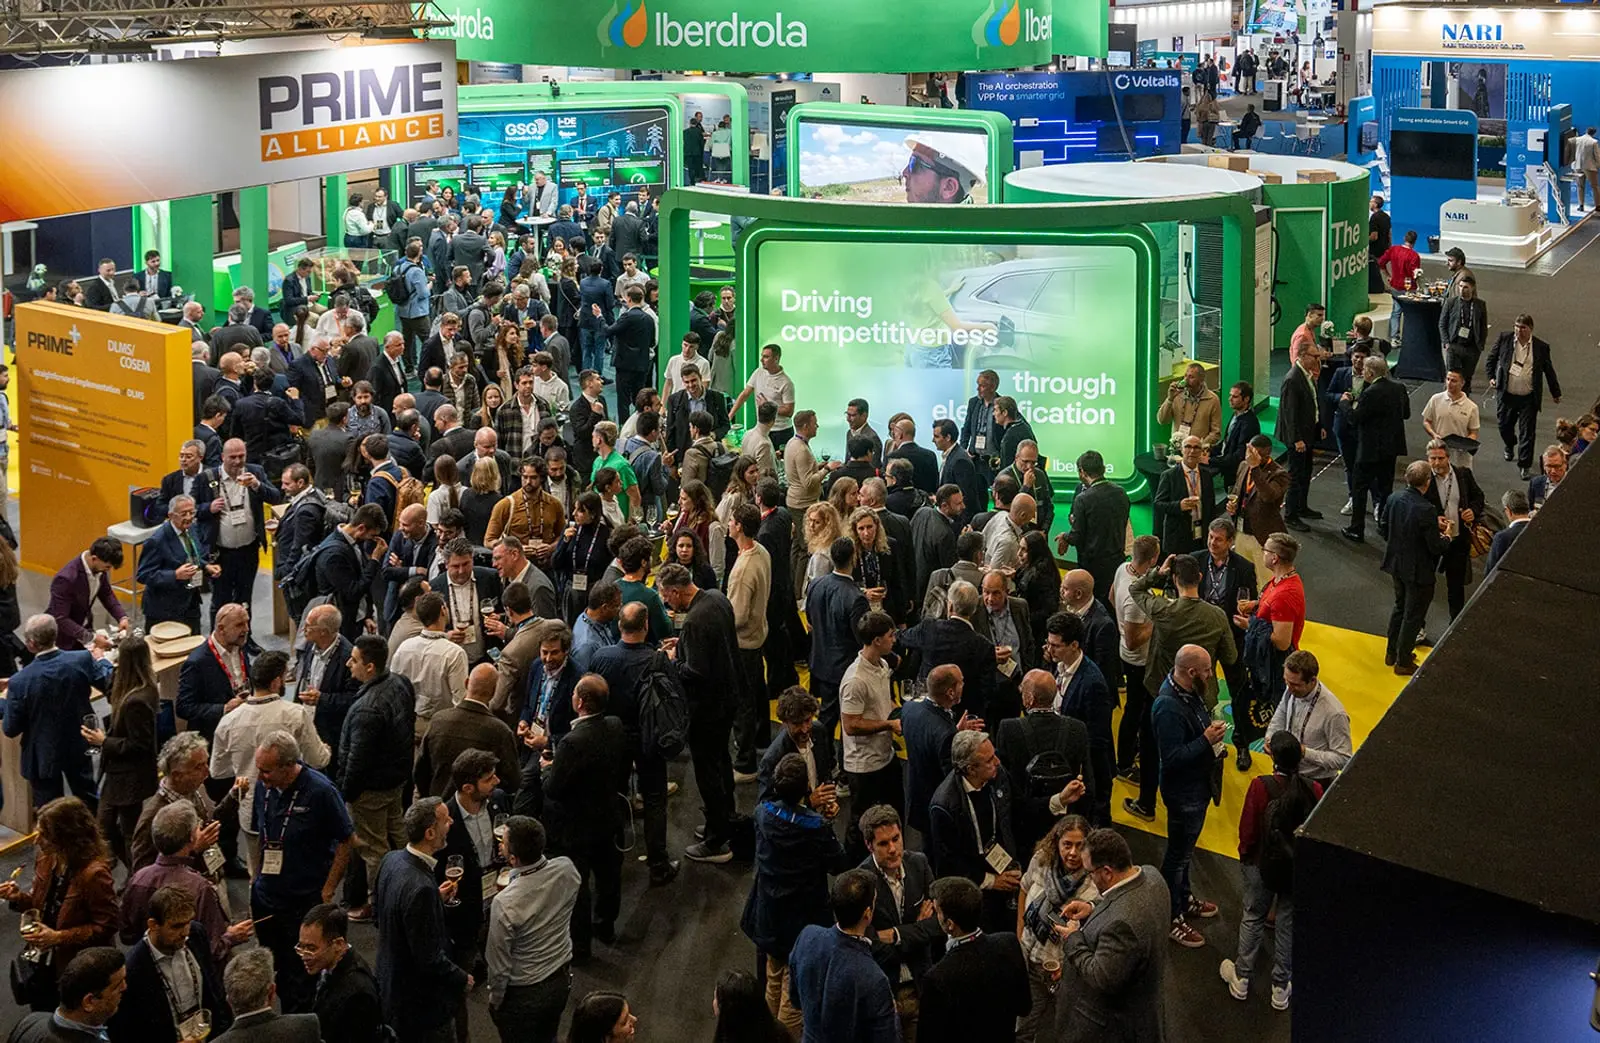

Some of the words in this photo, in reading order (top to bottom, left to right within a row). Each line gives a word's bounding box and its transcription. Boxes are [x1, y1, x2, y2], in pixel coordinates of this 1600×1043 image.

[655, 12, 808, 48] Iberdrola
[1442, 24, 1502, 41] NARI
[978, 82, 994, 91] The
[995, 82, 1003, 90] AI
[1005, 81, 1058, 90] orchestration
[1132, 75, 1179, 88] Voltalis
[258, 62, 443, 130] PRIME
[978, 92, 995, 101] VPP
[996, 92, 1008, 101] for
[1016, 92, 1047, 100] smarter
[1048, 91, 1065, 101] grid
[265, 117, 441, 157] ALLIANCE
[1445, 211, 1469, 221] NARI
[1331, 220, 1360, 250] The
[781, 289, 873, 318] Driving
[781, 321, 999, 348] competitiveness
[107, 339, 136, 357] DLMS/
[120, 355, 151, 374] COSEM
[1012, 371, 1116, 399] through
[932, 400, 1116, 425] elefication
[1052, 459, 1114, 474] Ibera
